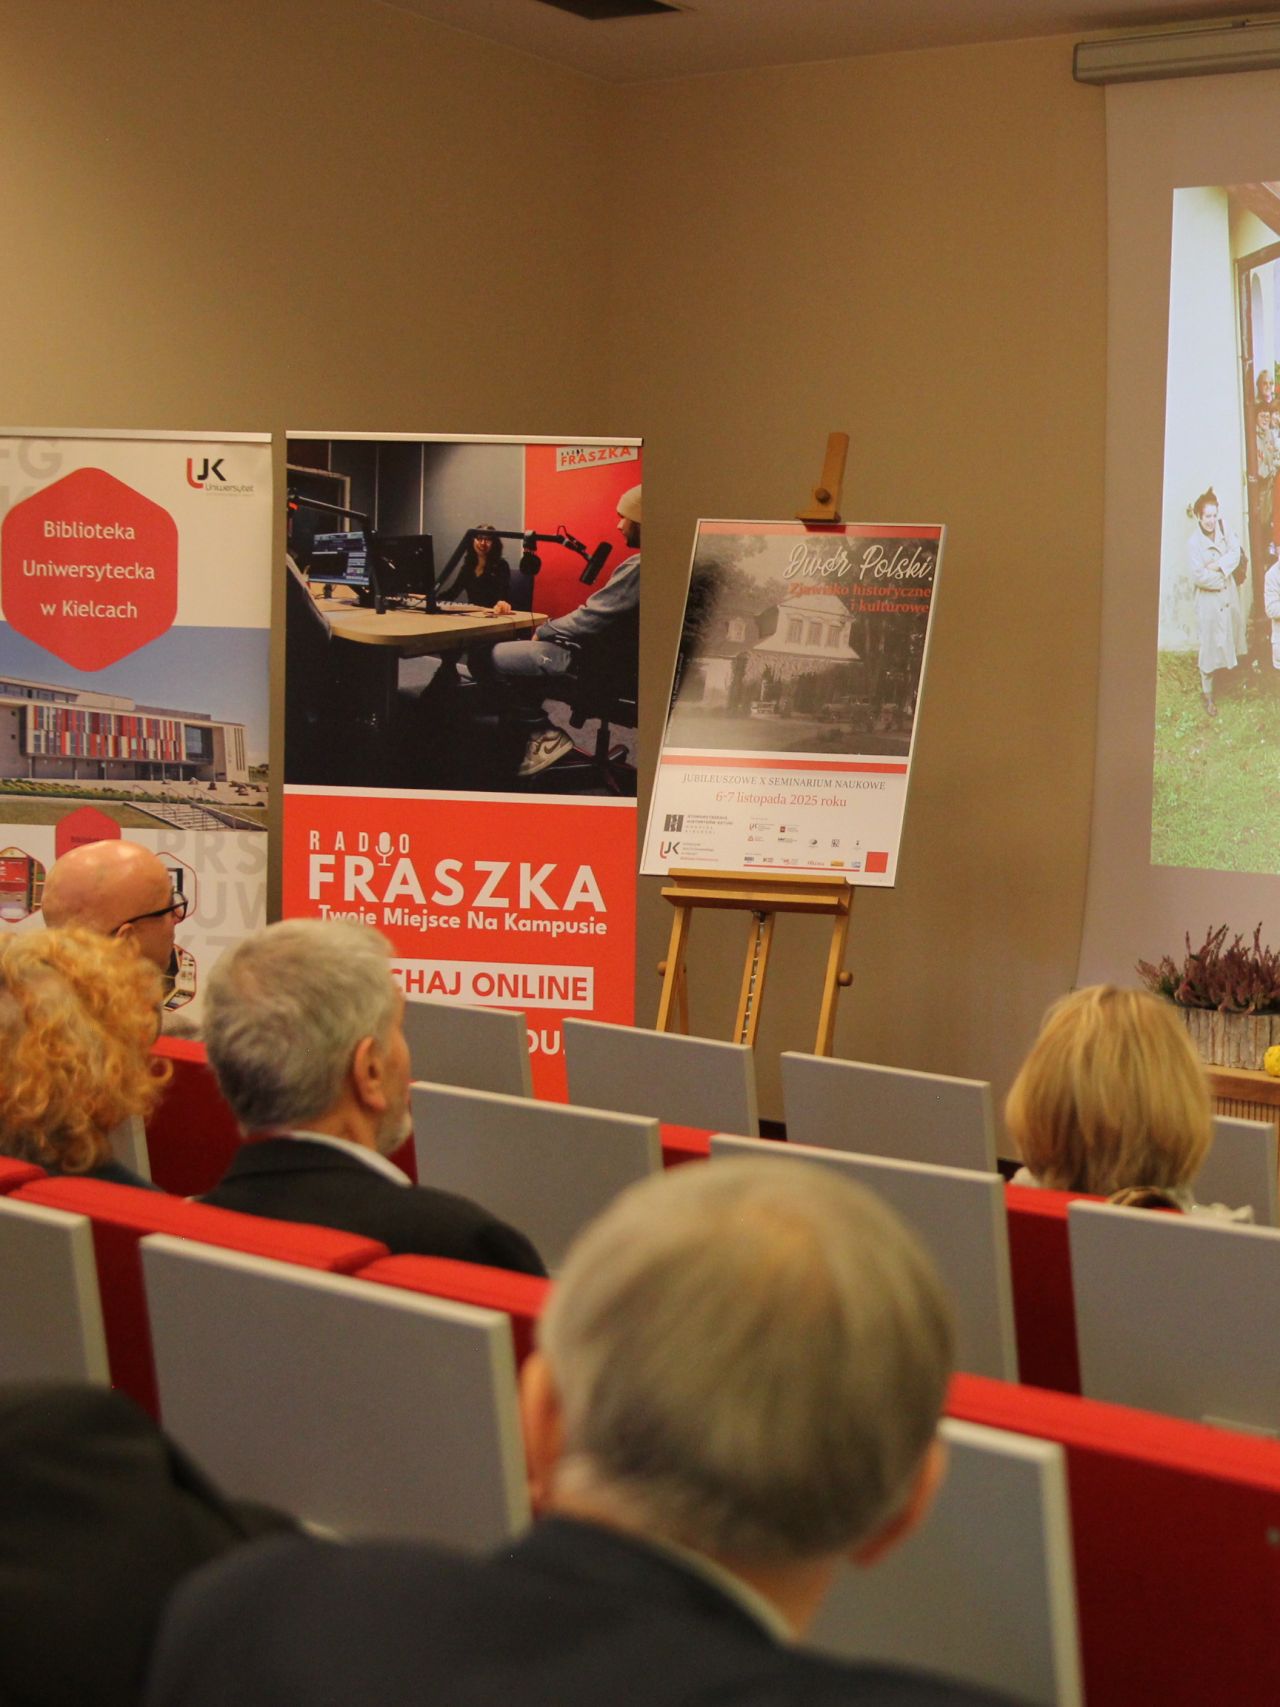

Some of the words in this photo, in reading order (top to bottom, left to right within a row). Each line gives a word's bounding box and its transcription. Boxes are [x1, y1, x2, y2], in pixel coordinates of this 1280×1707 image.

[561, 446, 631, 466] FRASZKA
[187, 458, 227, 489] UJK
[44, 520, 136, 540] Biblioteka
[22, 559, 155, 582] Uniwersytecka
[783, 543, 852, 579] Dwór
[859, 544, 933, 582] Polski.
[853, 583, 931, 598] historyczne
[41, 603, 56, 616] w
[62, 600, 138, 619] Kielcach
[859, 600, 929, 613] kulturowe
[682, 773, 757, 785] JUBILEUSZOWE
[759, 776, 765, 785] X
[768, 776, 832, 788] SEMINARIUM
[835, 779, 886, 791] NAUKOWE
[716, 791, 735, 802] 6-7
[737, 791, 787, 806] listopada
[790, 794, 818, 805] 2025
[821, 793, 847, 806] roku
[308, 853, 607, 913] FRASZKA
[383, 907, 461, 932] Miejsce
[467, 911, 498, 930] Na
[504, 912, 607, 938] Kampusie
[472, 972, 588, 1002] ONLINE
